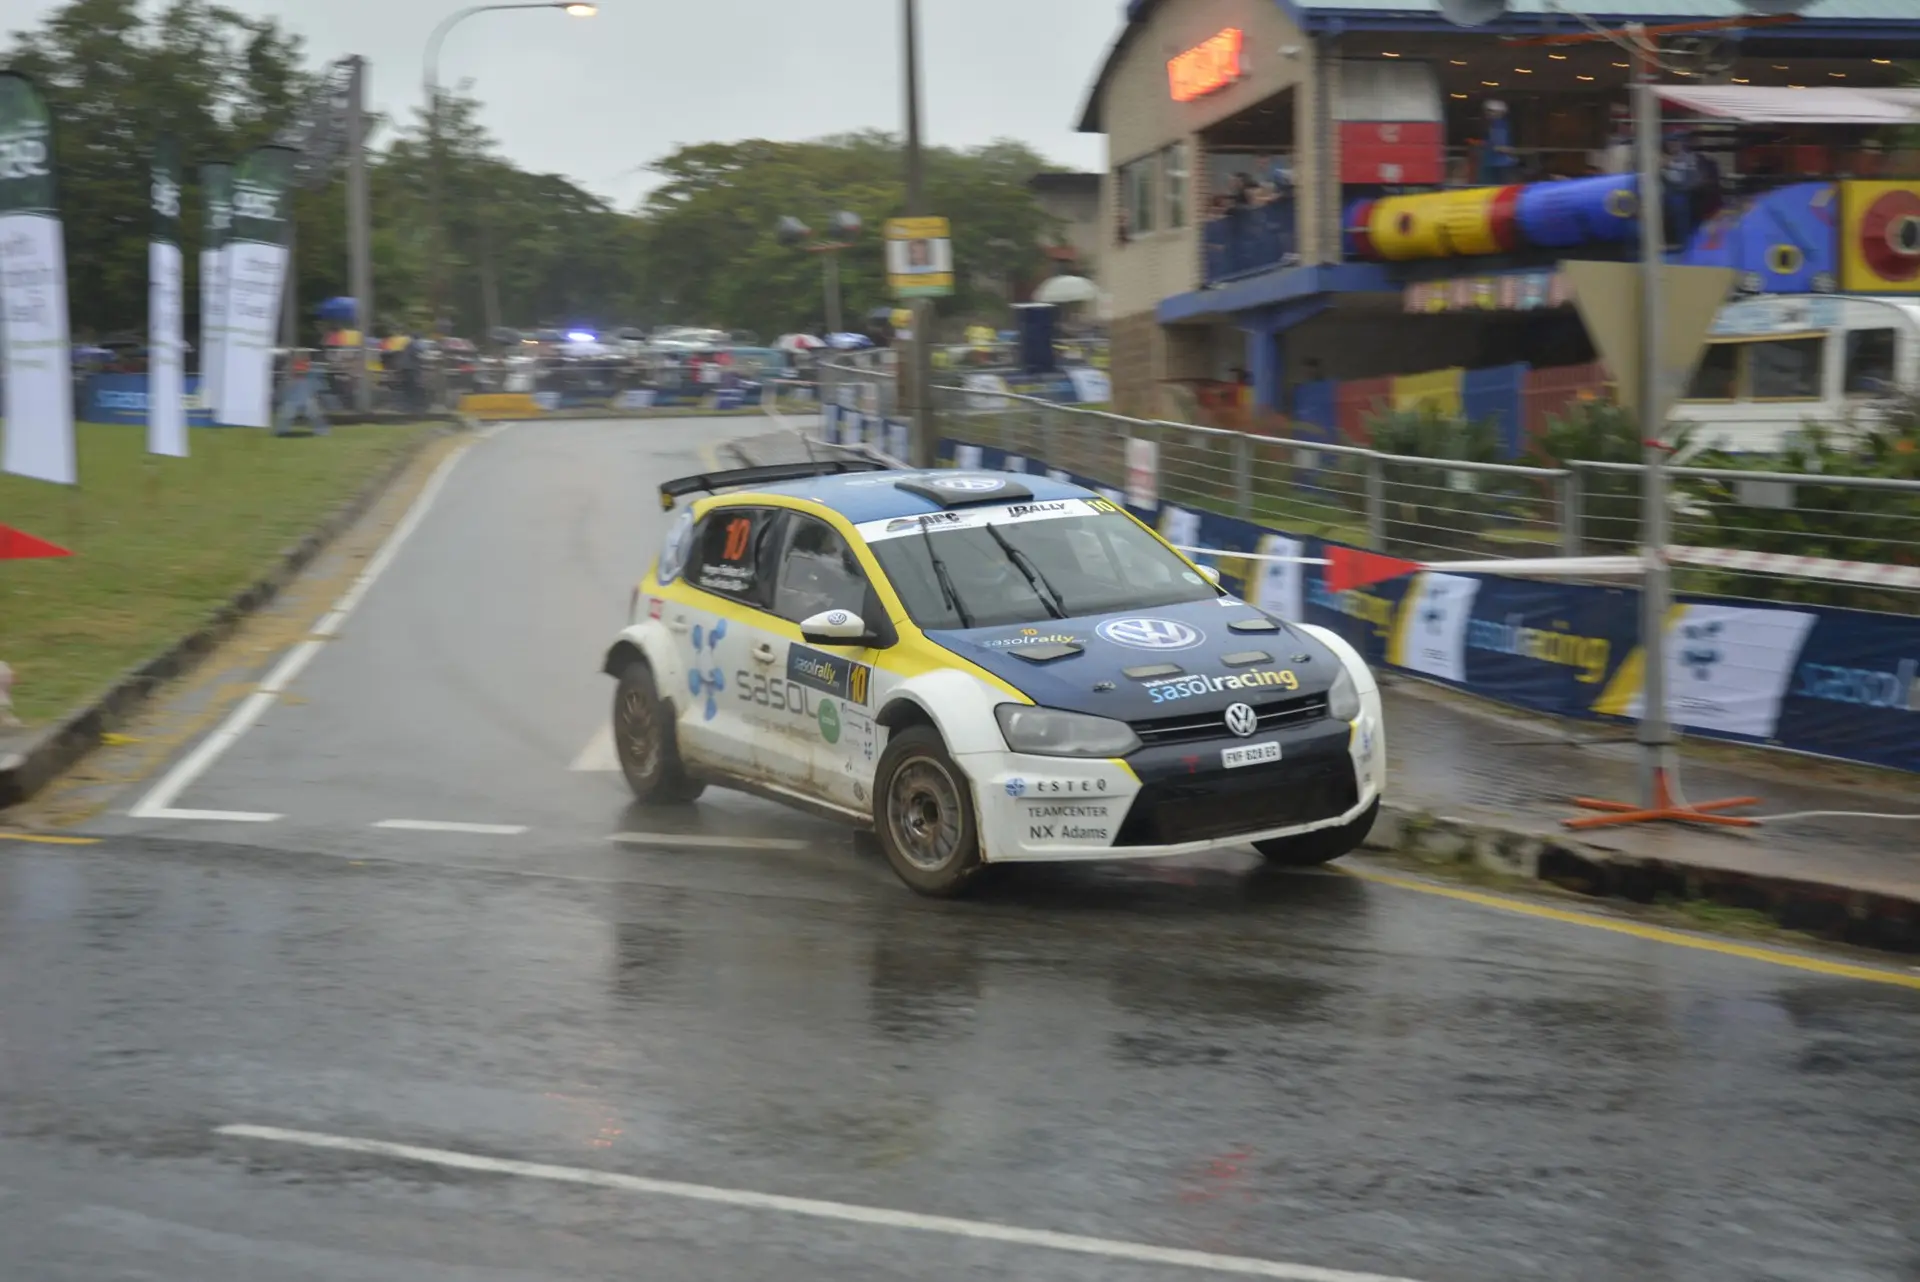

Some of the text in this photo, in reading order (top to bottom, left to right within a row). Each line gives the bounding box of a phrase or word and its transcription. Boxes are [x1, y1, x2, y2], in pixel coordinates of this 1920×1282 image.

[1086, 500, 1117, 513] 10
[722, 518, 752, 560] 10
[1020, 628, 1038, 636] 10
[982, 634, 1075, 648] sasolrally
[850, 664, 867, 704] 10
[1148, 668, 1299, 704] sasolracing
[1028, 806, 1109, 818] TEAMCENTER
[1030, 824, 1108, 839] NX Adams
